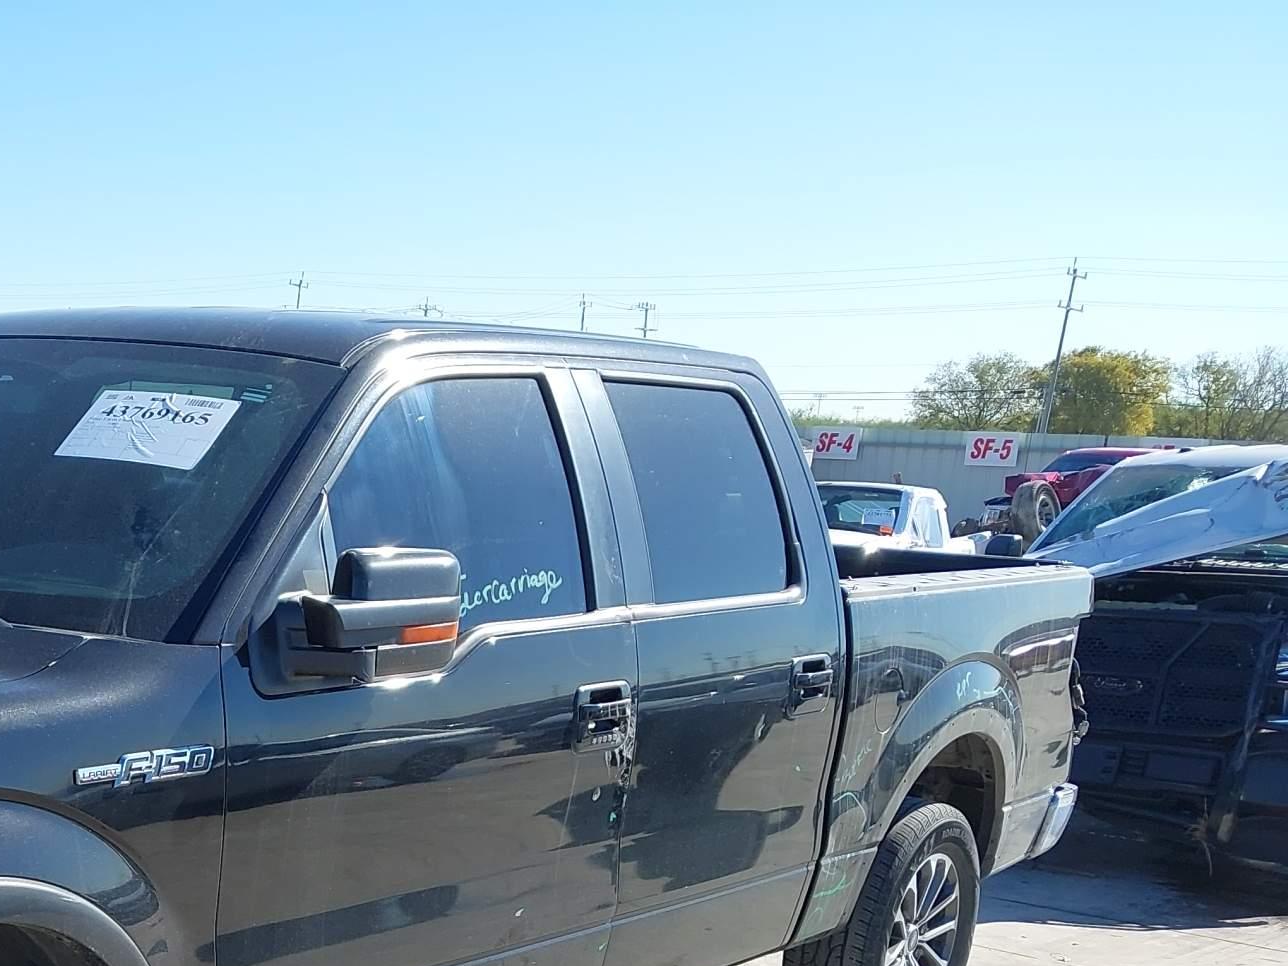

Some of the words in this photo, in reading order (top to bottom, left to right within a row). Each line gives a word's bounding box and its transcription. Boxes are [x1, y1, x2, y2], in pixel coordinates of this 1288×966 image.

[101, 403, 213, 426] 43769165
[815, 432, 856, 453] SF-4
[970, 437, 1013, 460] SF-5
[113, 745, 215, 788] F-150
